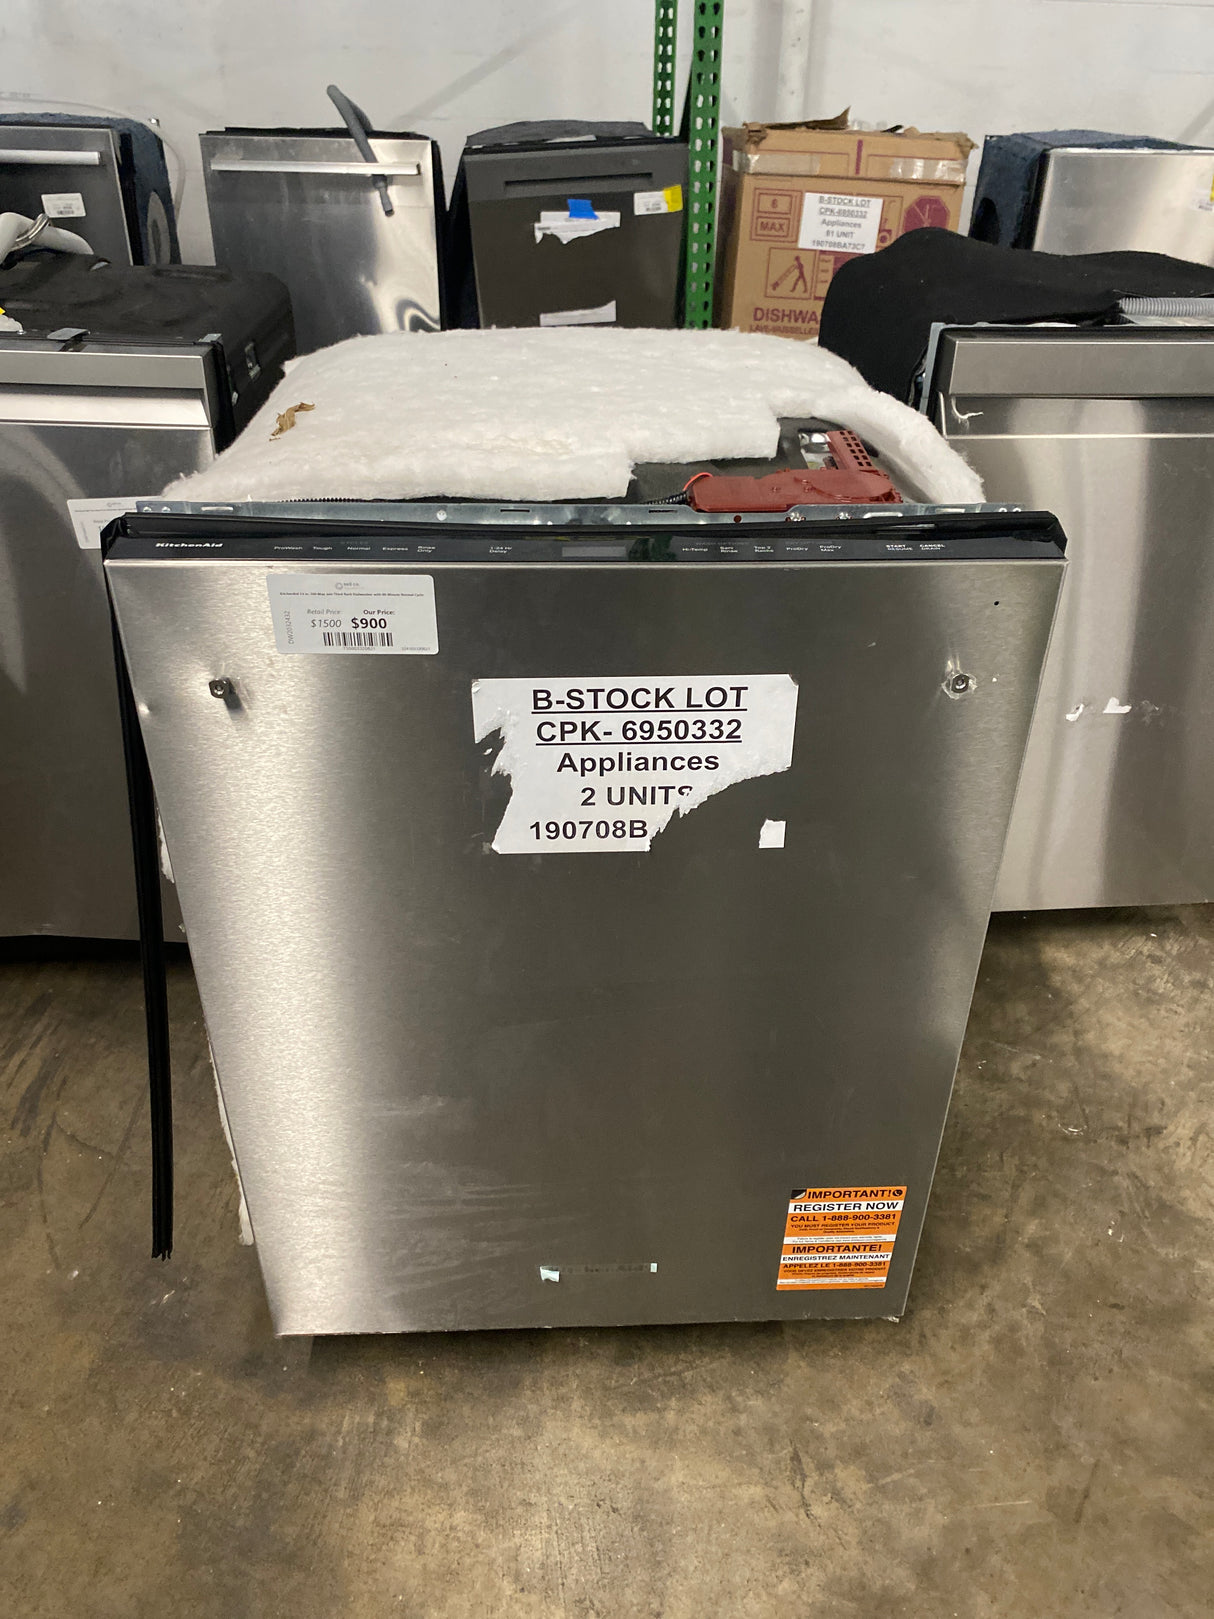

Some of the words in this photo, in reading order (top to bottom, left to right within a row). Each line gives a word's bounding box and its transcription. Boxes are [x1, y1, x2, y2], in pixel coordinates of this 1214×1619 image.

[856, 199, 871, 208] LOT
[760, 221, 785, 233] MAX
[821, 218, 862, 229] Appliances
[311, 619, 342, 628] $1500
[351, 617, 387, 630] $900
[532, 688, 674, 710] B-STOCK
[686, 686, 748, 708] LOT
[536, 721, 612, 742] CPK-
[622, 719, 742, 740] 6950332
[556, 752, 720, 776] Appliances
[580, 787, 596, 806] 2
[530, 820, 648, 840] 190708B
[808, 1190, 892, 1200] IMPORTANT!
[794, 1203, 862, 1212] REGISTER
[866, 1202, 899, 1210] NOW
[822, 1214, 896, 1222] 1-888-900-3381
[792, 1244, 882, 1254] IMPORTANTE!
